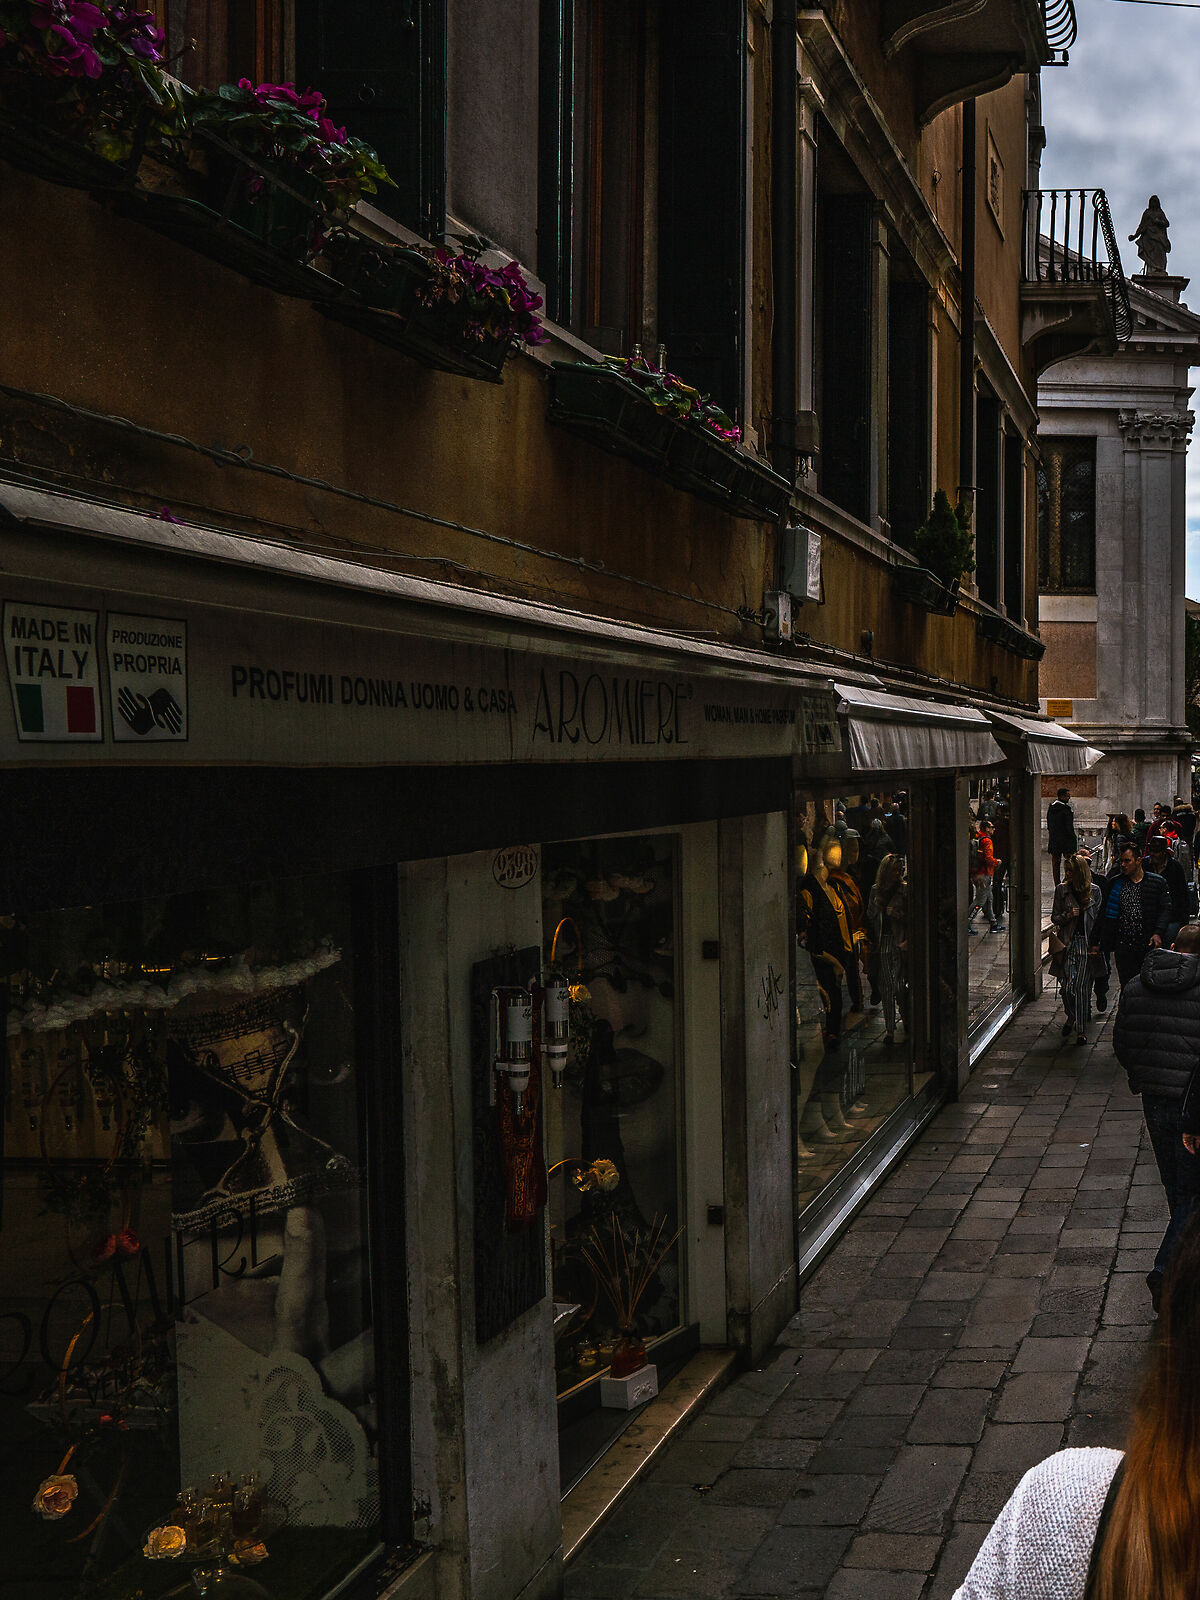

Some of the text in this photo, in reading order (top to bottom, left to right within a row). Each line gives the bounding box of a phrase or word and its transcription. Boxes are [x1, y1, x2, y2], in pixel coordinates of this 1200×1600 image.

[12, 616, 92, 644] MADE IN
[112, 630, 183, 648] PRODUZIONE
[14, 646, 89, 679] ITALY
[113, 653, 183, 675] PROPRIA
[231, 665, 518, 714] PROFUMI DONNA UOMO & CASA
[533, 669, 688, 744] AROMIERE
